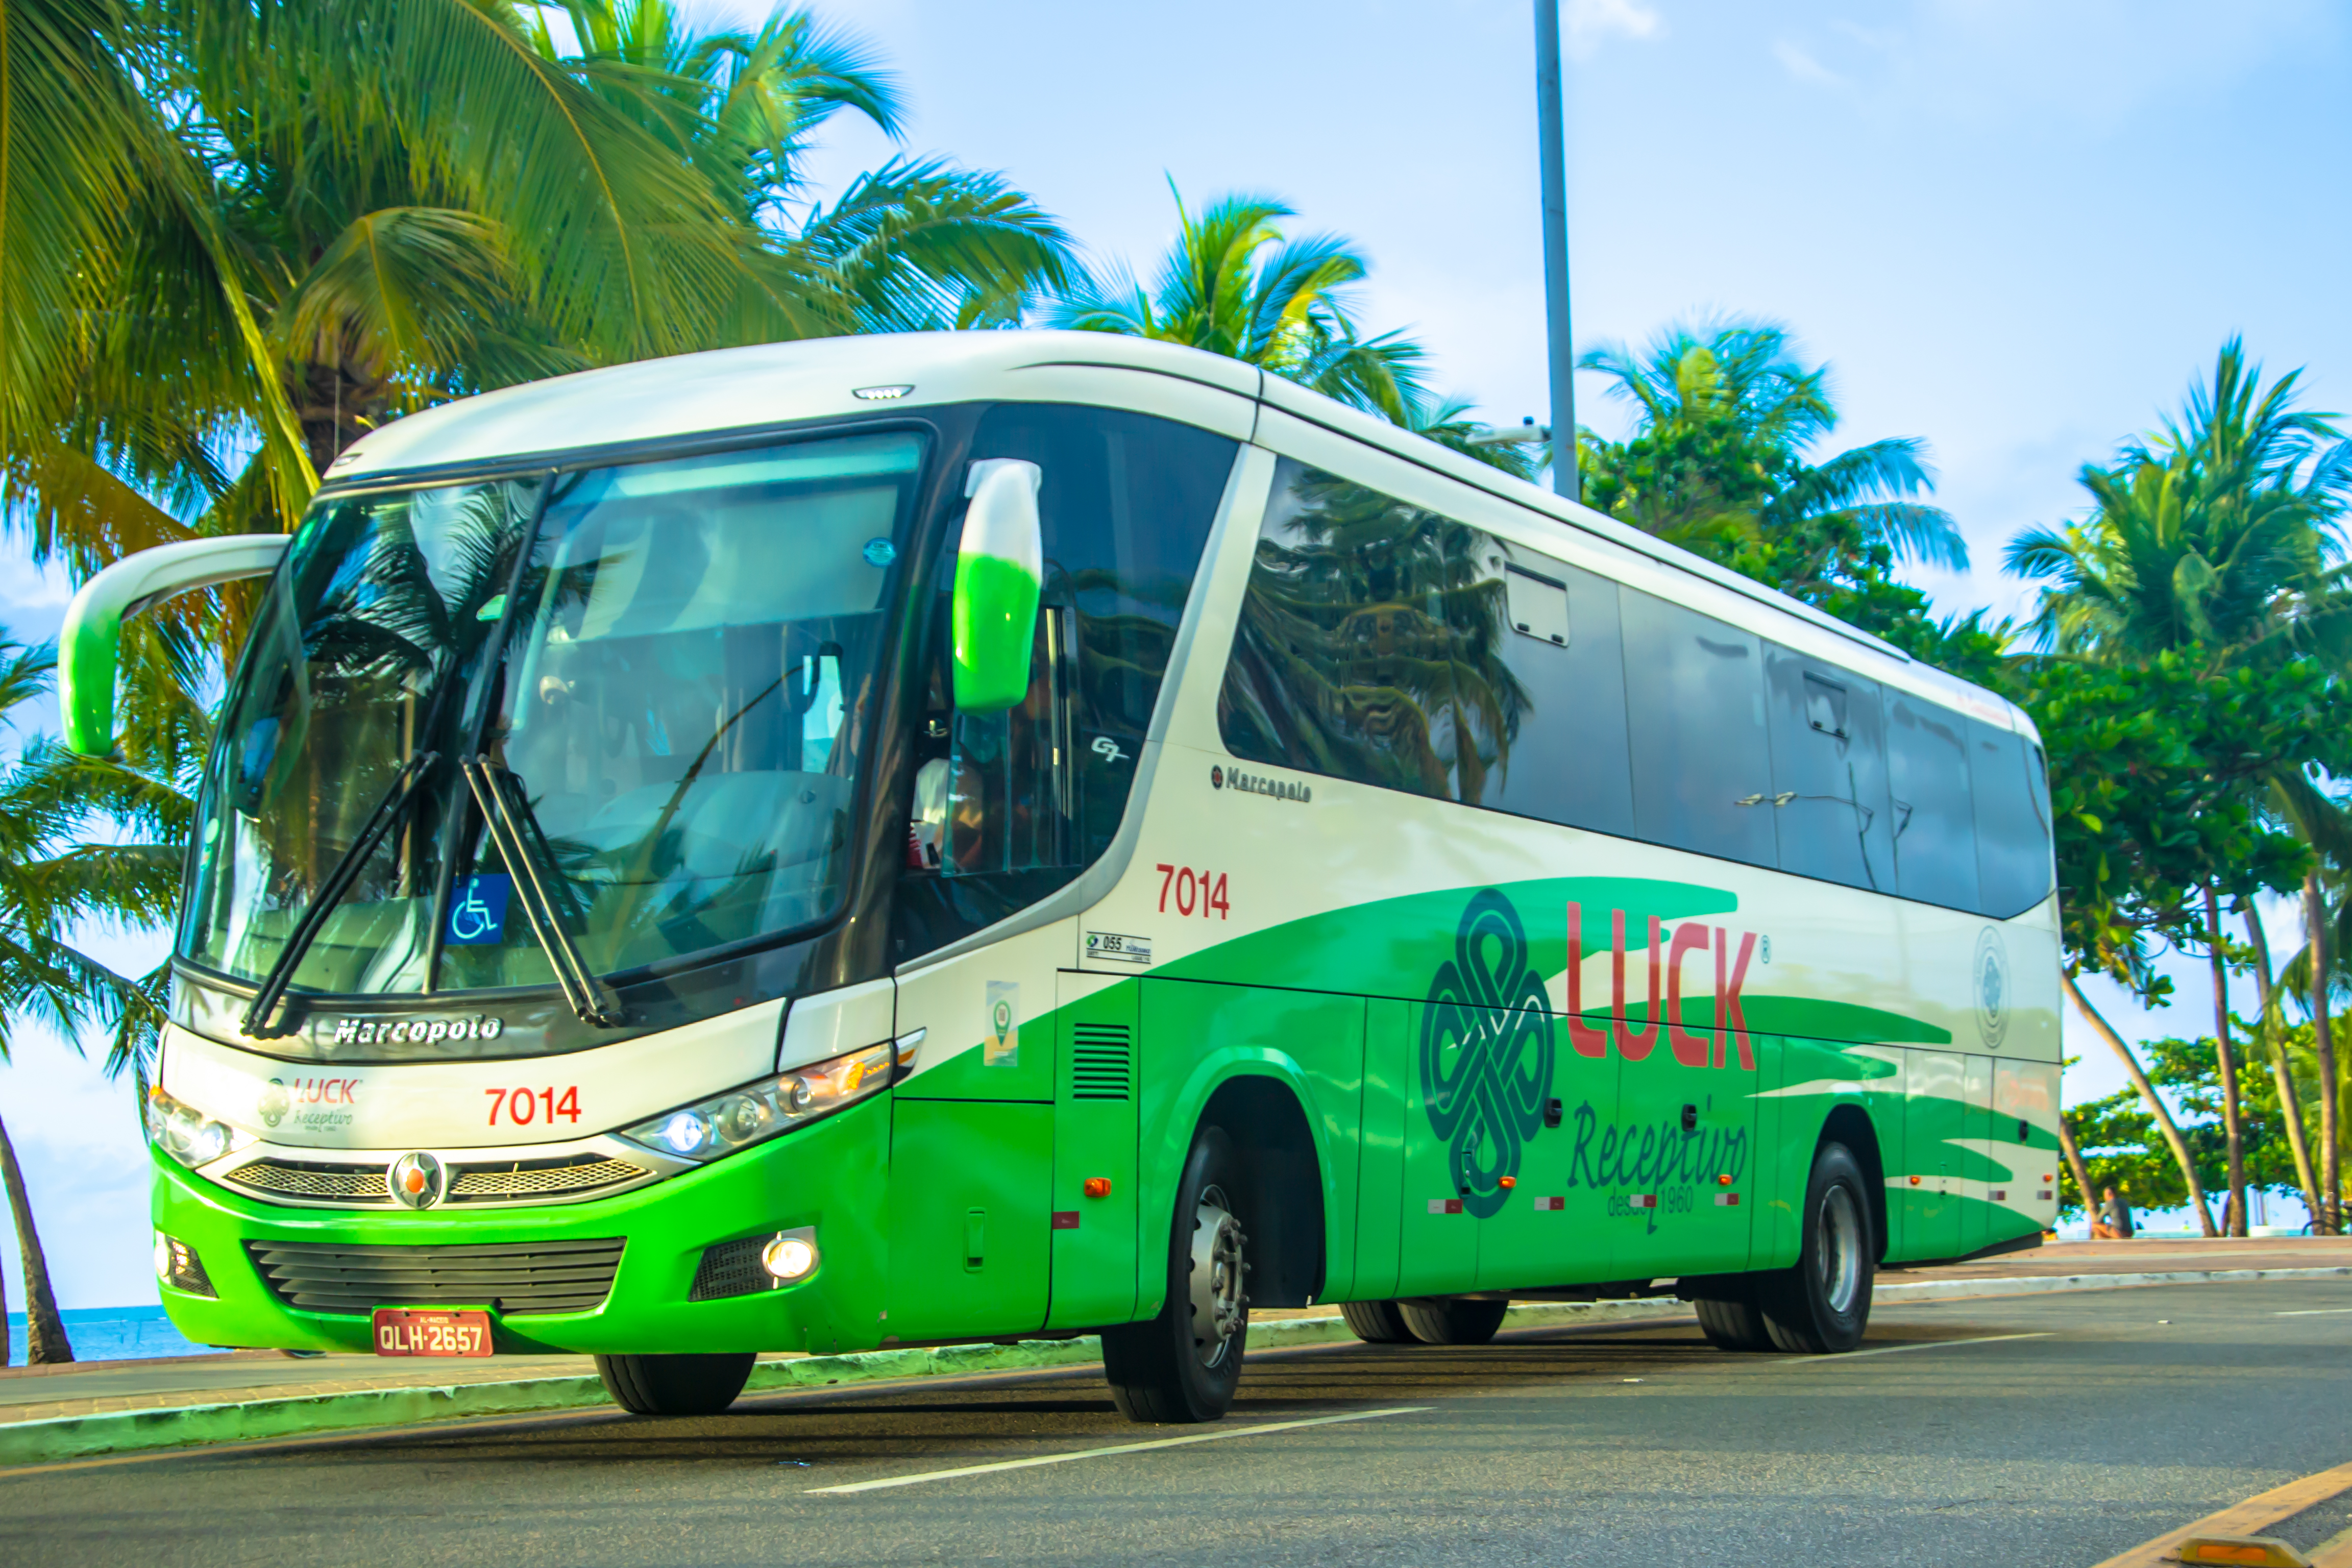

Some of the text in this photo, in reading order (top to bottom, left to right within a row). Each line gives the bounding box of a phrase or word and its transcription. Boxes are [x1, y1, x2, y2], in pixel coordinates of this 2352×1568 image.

[1226, 767, 1312, 803] Marcopolo
[1156, 863, 1230, 920] 7014
[1103, 936, 1122, 950] 055
[1567, 900, 1757, 1071] LUCK
[334, 1014, 504, 1045] Marcopolo
[294, 1078, 358, 1104] LUCK
[485, 1086, 582, 1126] 7014
[1567, 1093, 1747, 1235] Receptivo
[1661, 1185, 1693, 1214] 1960
